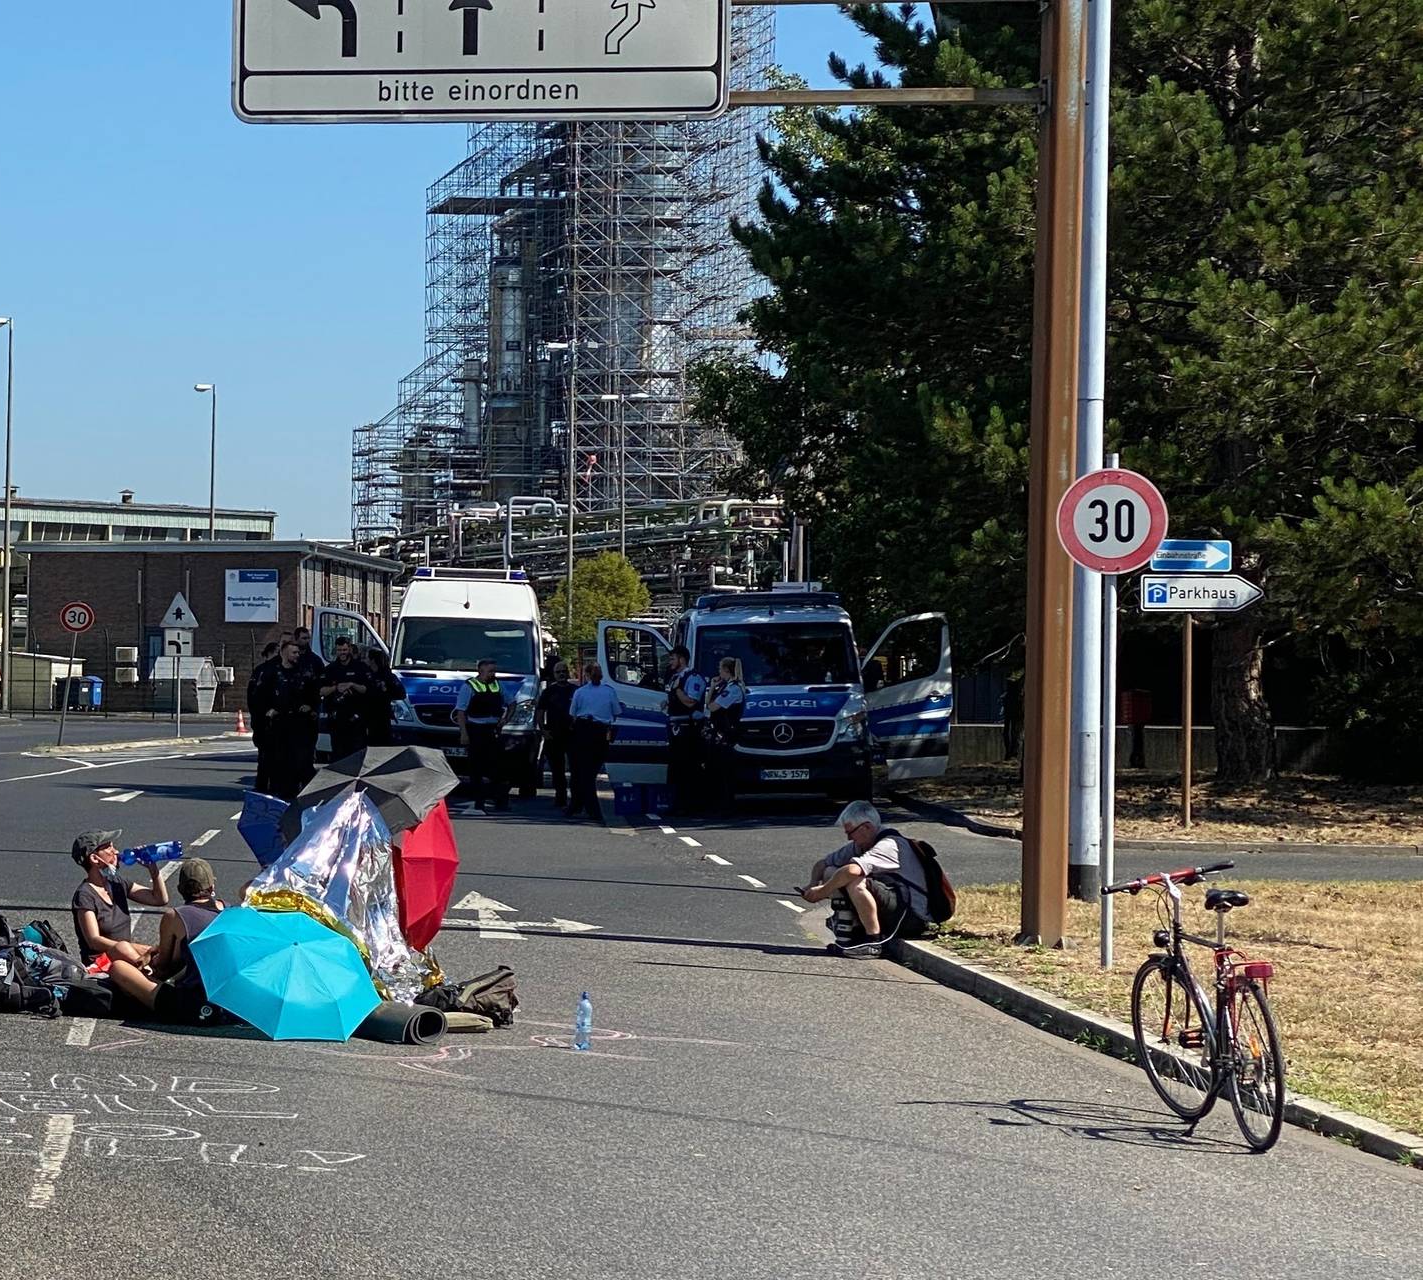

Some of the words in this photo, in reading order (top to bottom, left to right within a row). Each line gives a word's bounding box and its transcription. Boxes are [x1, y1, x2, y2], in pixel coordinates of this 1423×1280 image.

[378, 79, 434, 101] bitte
[448, 78, 579, 101] einordnen
[1088, 499, 1135, 543] 30
[1169, 586, 1236, 600] Parkhaus
[67, 610, 87, 625] 30
[745, 699, 817, 709] POLIZEI
